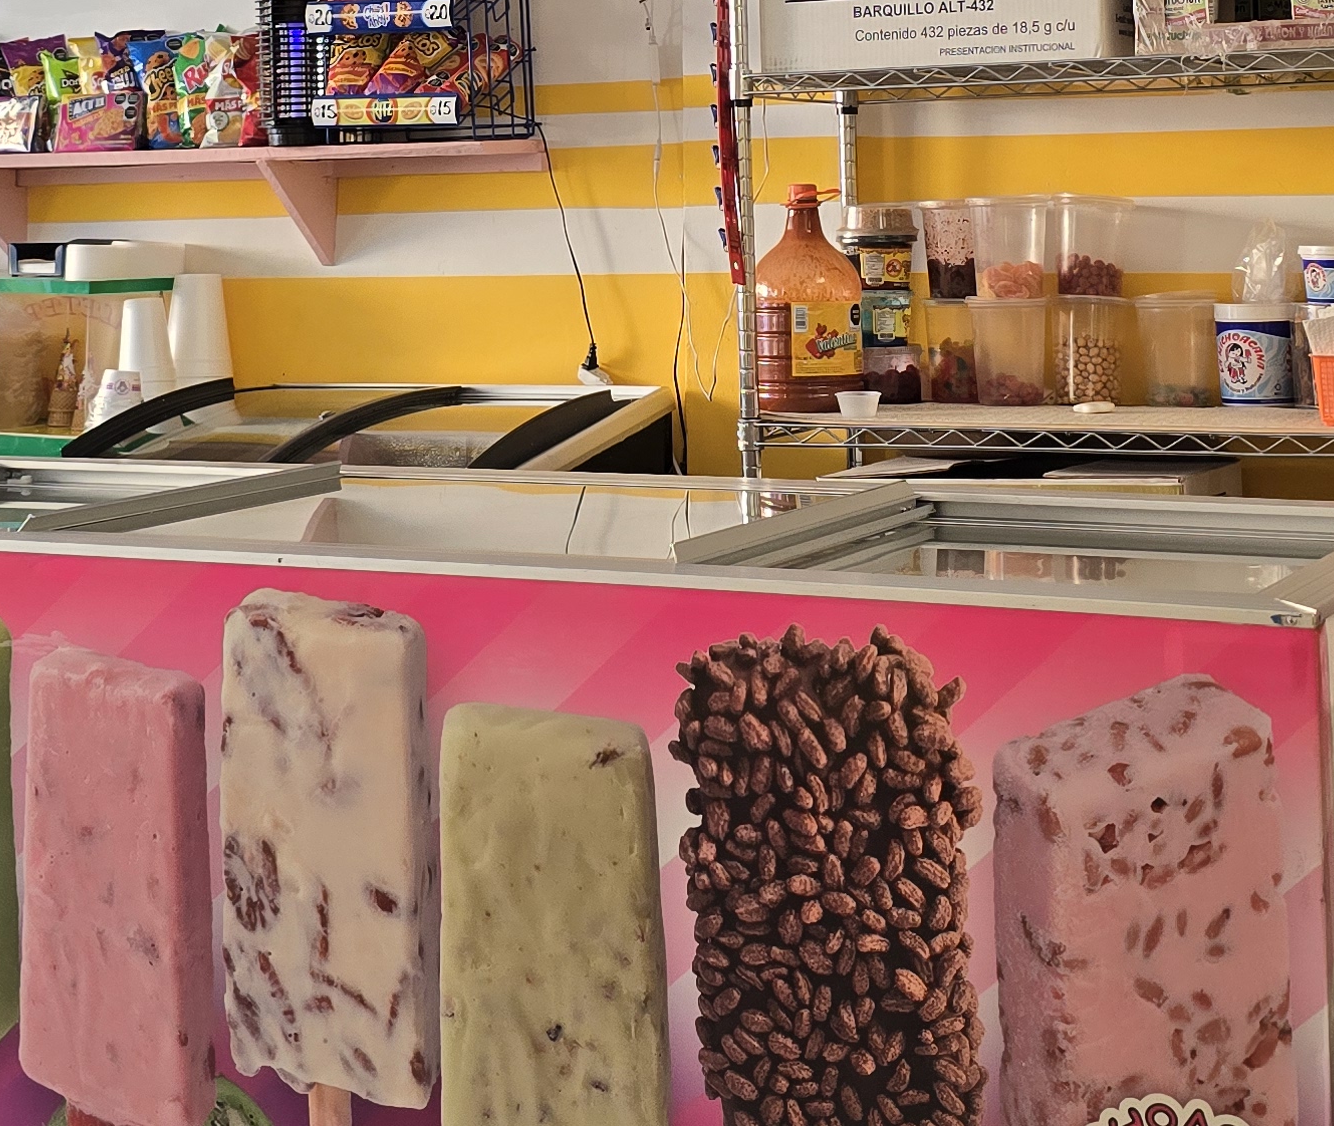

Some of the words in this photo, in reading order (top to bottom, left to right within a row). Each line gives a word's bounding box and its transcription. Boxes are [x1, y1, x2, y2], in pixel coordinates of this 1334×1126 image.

[852, 2, 935, 19] BARQUILLO
[854, 27, 917, 42] Contenido
[920, 25, 944, 39] 432
[947, 23, 988, 40] piezas
[991, 22, 1008, 36] de
[1012, 20, 1040, 35] 18,5
[1043, 23, 1052, 36] g
[1055, 18, 1076, 32] c/u
[939, 44, 1007, 57] PRESENTACION
[1008, 42, 1076, 55] INSTITUCIONAL
